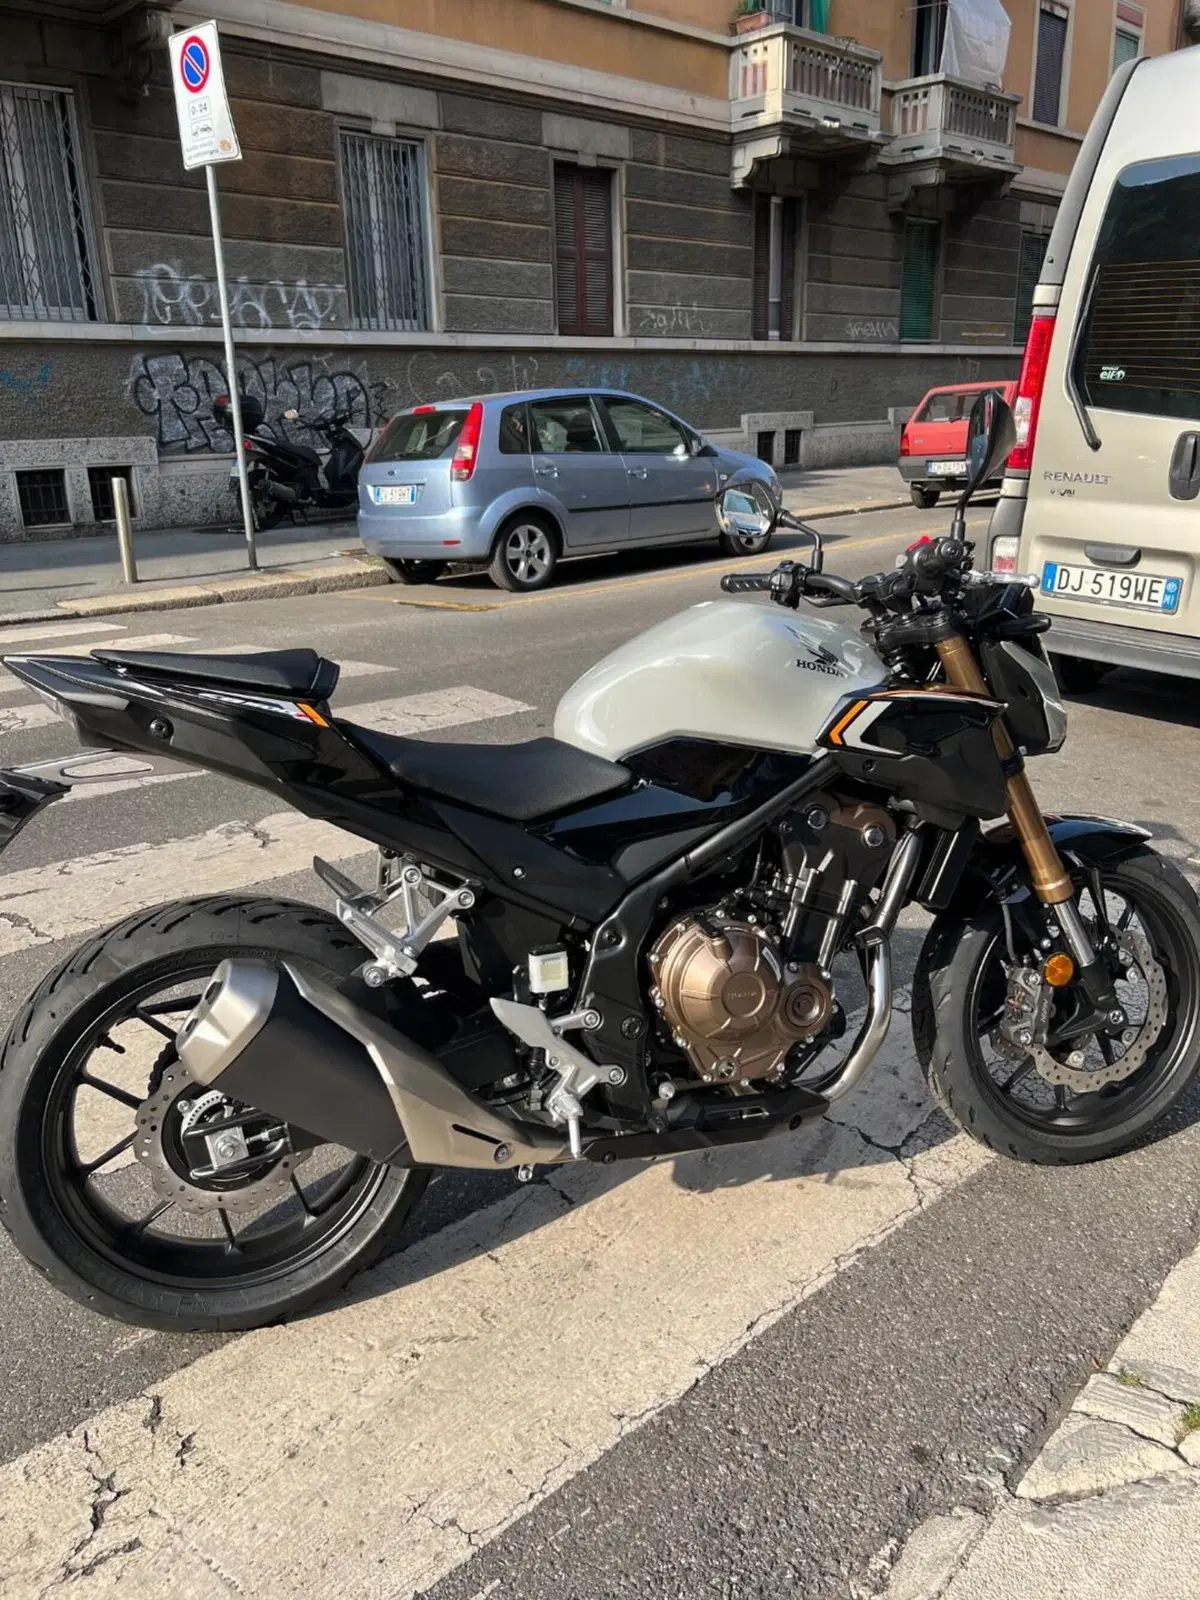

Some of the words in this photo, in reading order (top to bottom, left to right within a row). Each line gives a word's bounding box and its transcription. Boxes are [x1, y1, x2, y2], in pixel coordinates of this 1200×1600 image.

[1043, 471, 1113, 485] RENAULT
[1057, 568, 1084, 592] DJ
[1091, 573, 1162, 603] 519WE
[796, 659, 845, 678] HONDA
